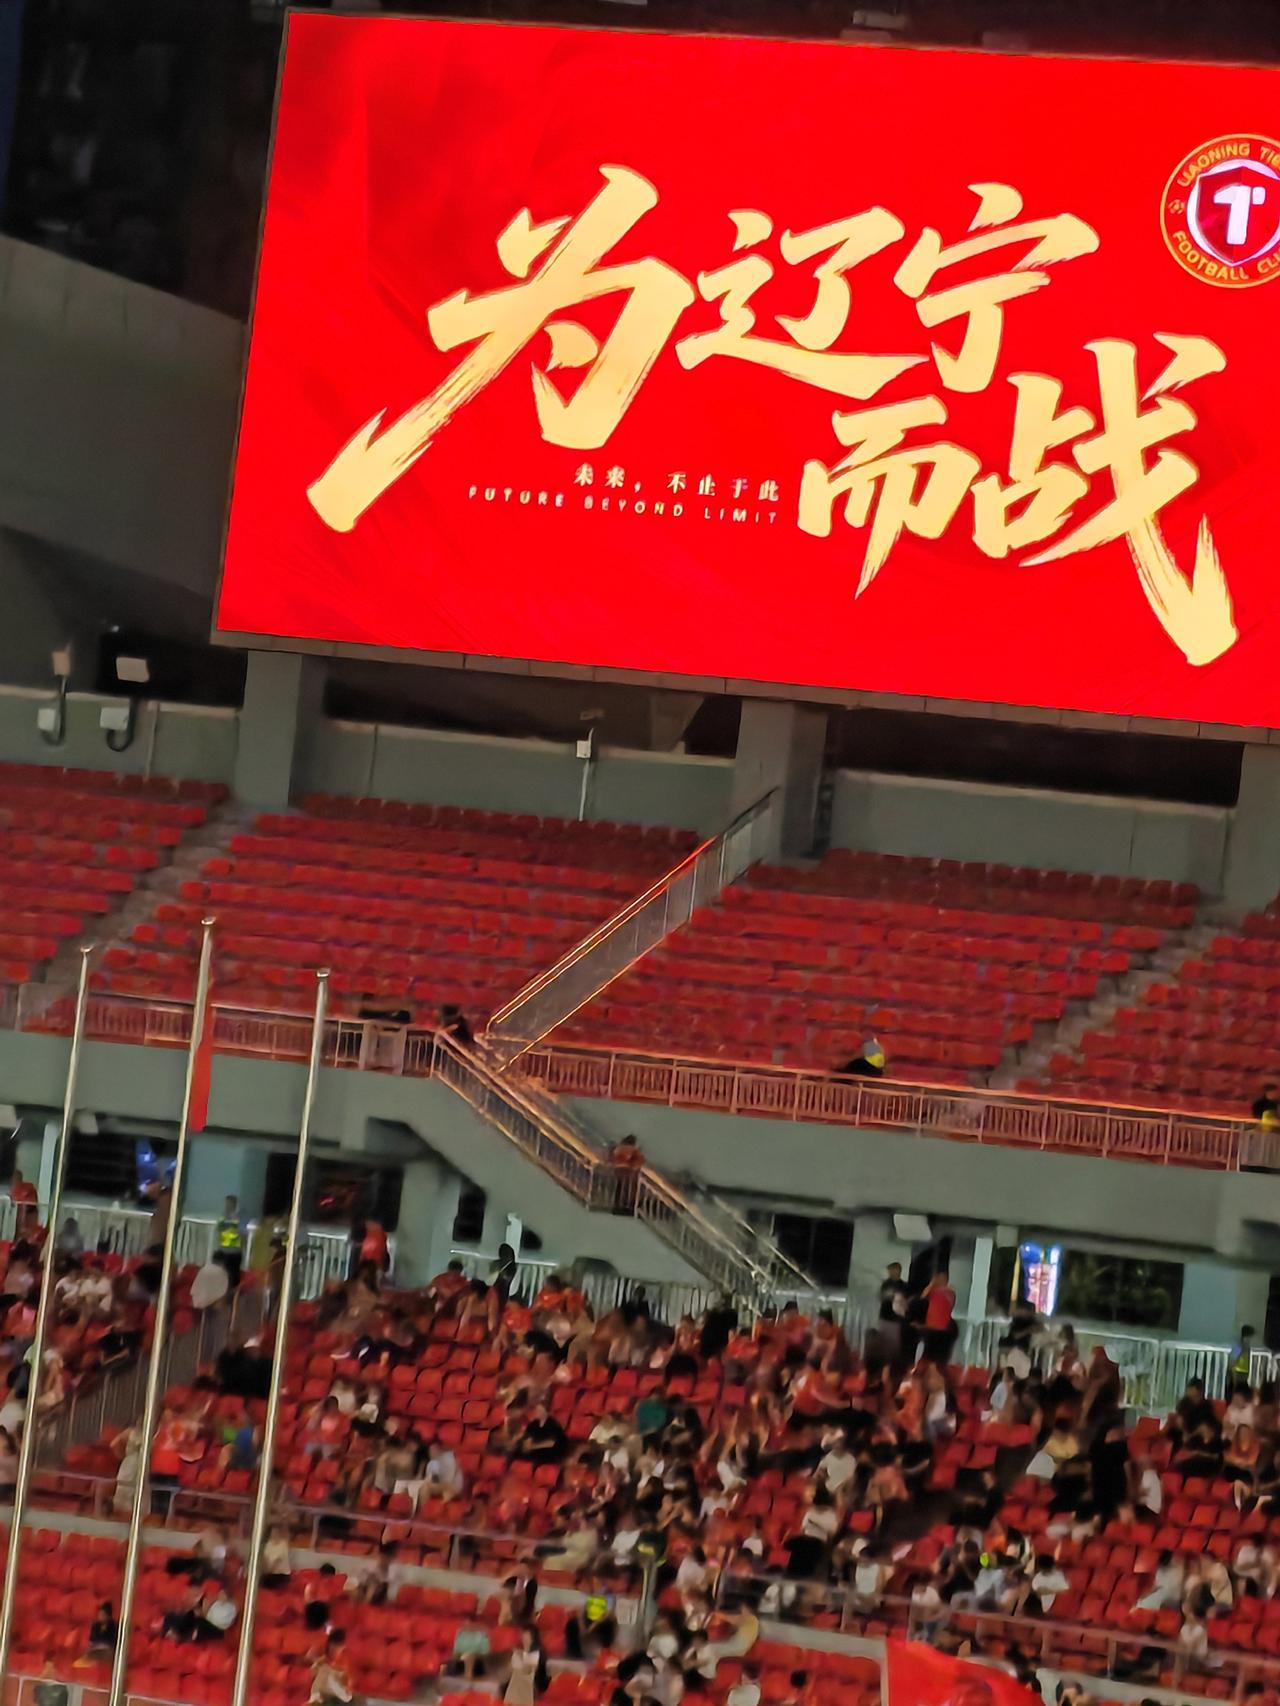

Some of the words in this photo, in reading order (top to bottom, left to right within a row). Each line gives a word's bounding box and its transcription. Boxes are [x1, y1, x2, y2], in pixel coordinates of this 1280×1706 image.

[1177, 143, 1251, 187] LIAONING
[1173, 230, 1249, 281] FOOTBALL
[306, 164, 1100, 533] 为辽宁
[468, 485, 565, 507] FUTURE
[584, 495, 684, 517] BEYOND
[703, 507, 777, 524] LIMIT
[797, 332, 1240, 667] 而战
